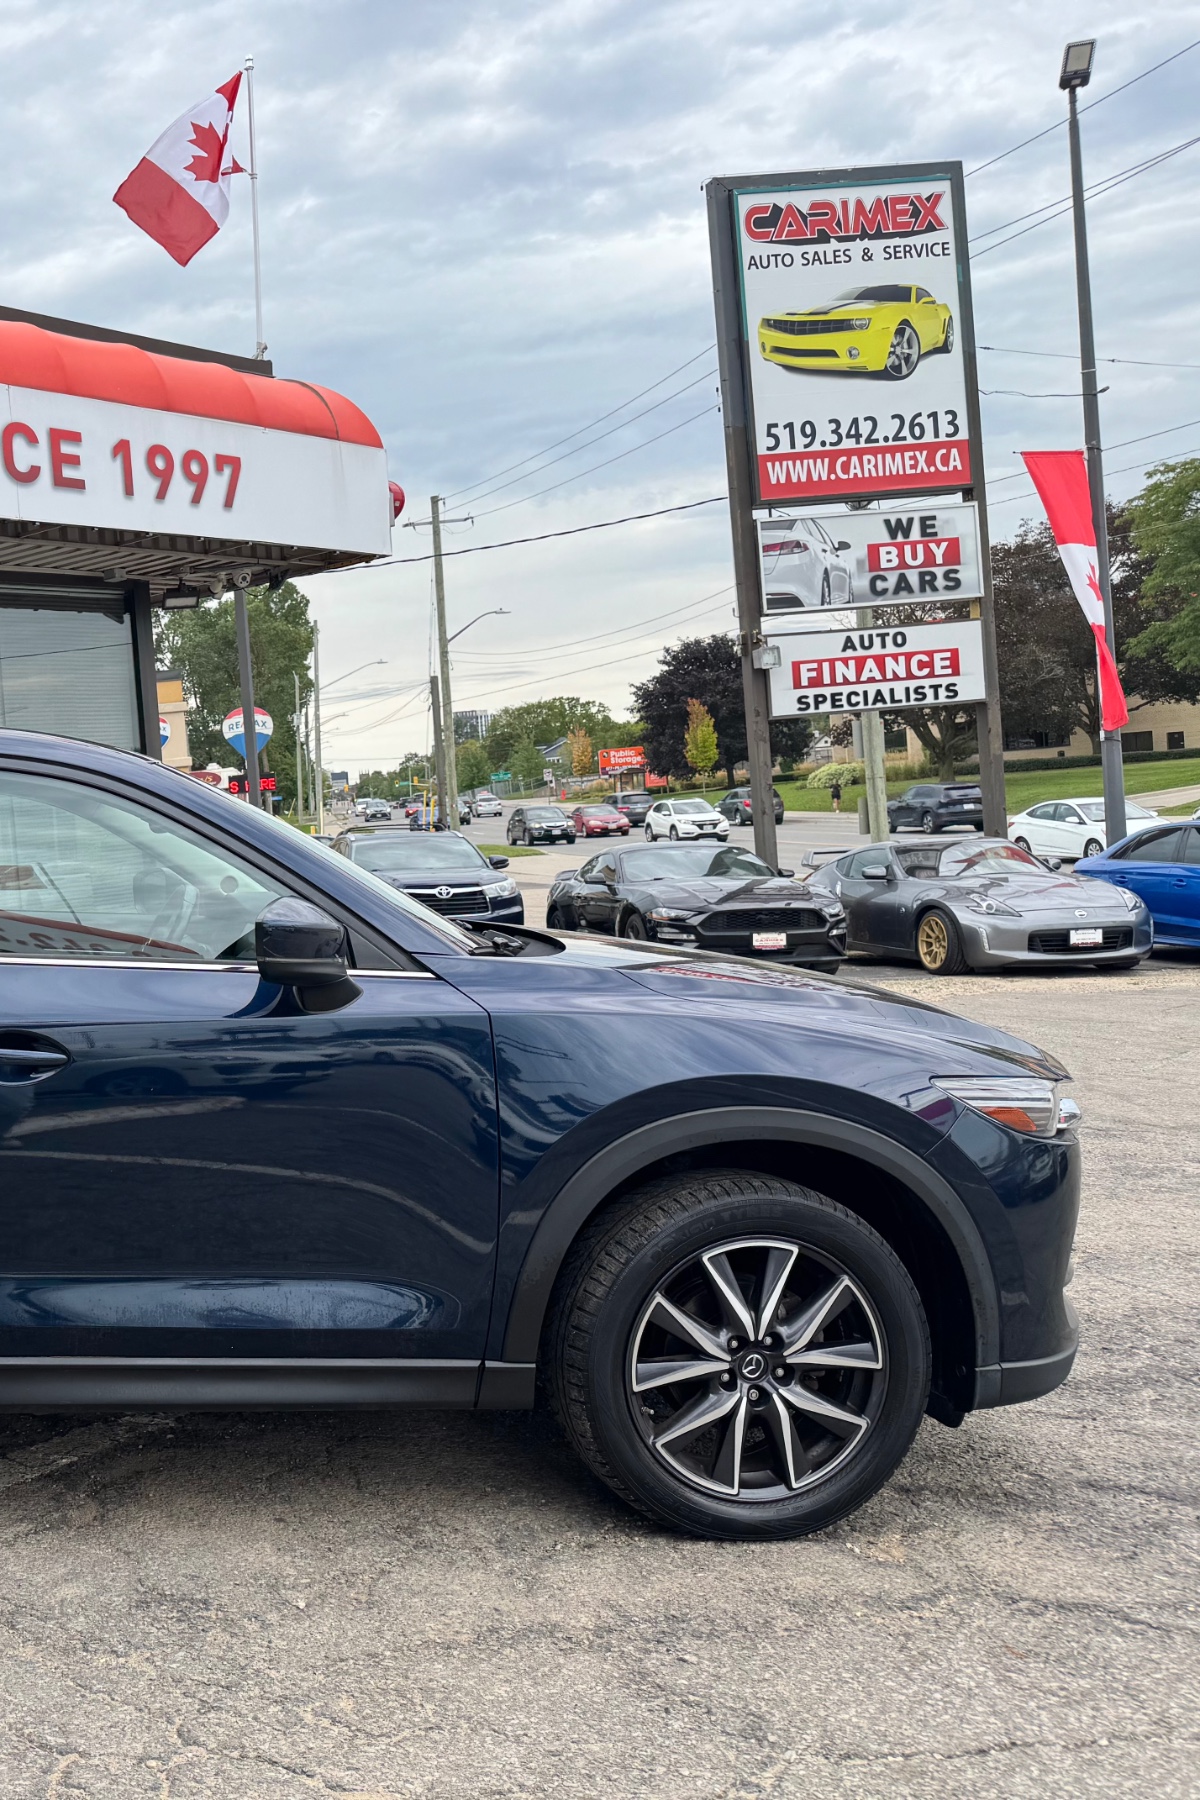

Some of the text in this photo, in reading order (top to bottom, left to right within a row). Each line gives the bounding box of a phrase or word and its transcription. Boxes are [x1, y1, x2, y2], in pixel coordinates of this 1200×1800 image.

[743, 191, 949, 244] CARIMEX
[748, 242, 950, 270] AUTO SALES & SERVICE
[766, 410, 960, 451] 519.342.2613
[113, 439, 242, 508] 1997
[766, 448, 962, 485] WWW.CARIMEX.CA
[883, 515, 938, 540] WE
[879, 541, 949, 569] BUY
[869, 569, 962, 596] CARS
[841, 631, 907, 652] AUTO
[800, 652, 952, 687] FINANCE
[796, 683, 959, 711] SPECIALISTS
[610, 756, 642, 764] Storage
